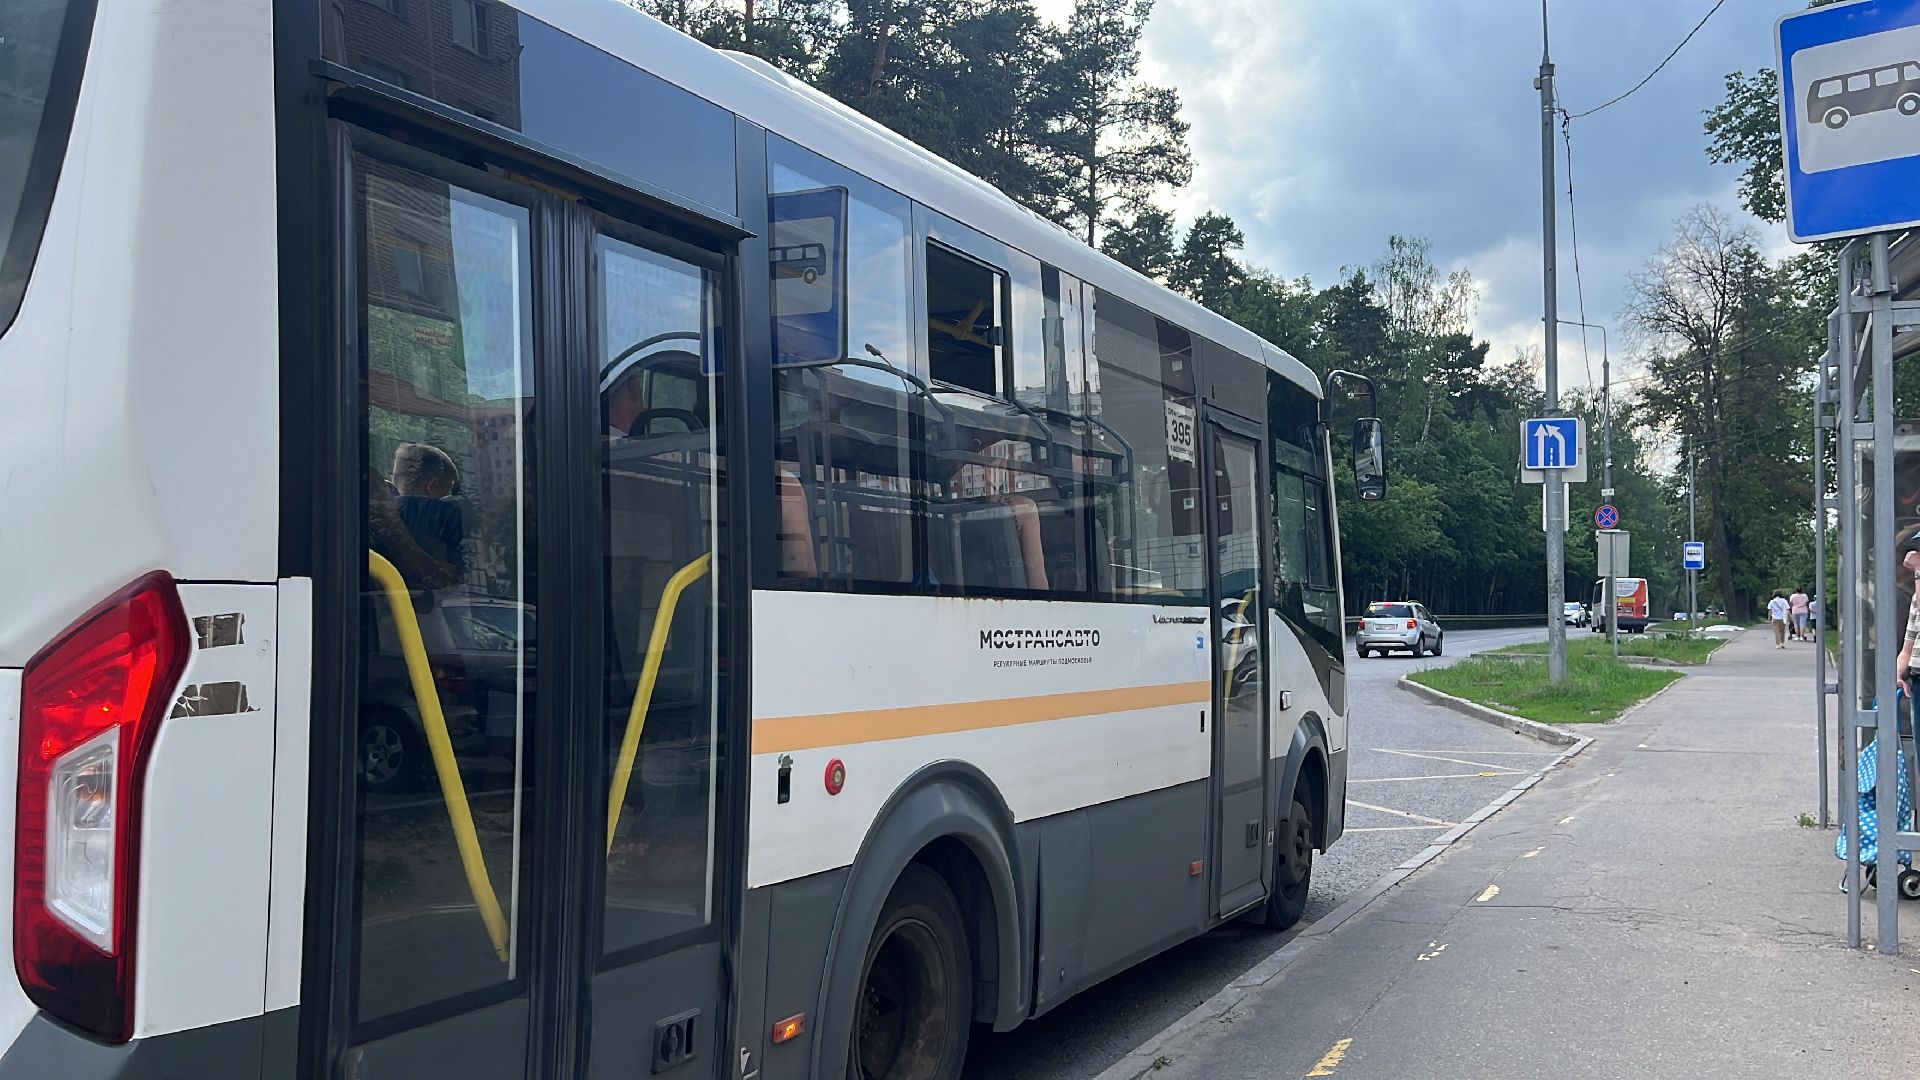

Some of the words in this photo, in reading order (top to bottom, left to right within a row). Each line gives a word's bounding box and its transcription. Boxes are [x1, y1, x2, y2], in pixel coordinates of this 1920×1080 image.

[1171, 419, 1191, 446] 395
[980, 629, 1100, 650] МОСТРАНСАВТО
[993, 659, 1027, 668] РЕГУЛЯРНЫЕ
[1028, 658, 1057, 666] МАРШРУТЫ
